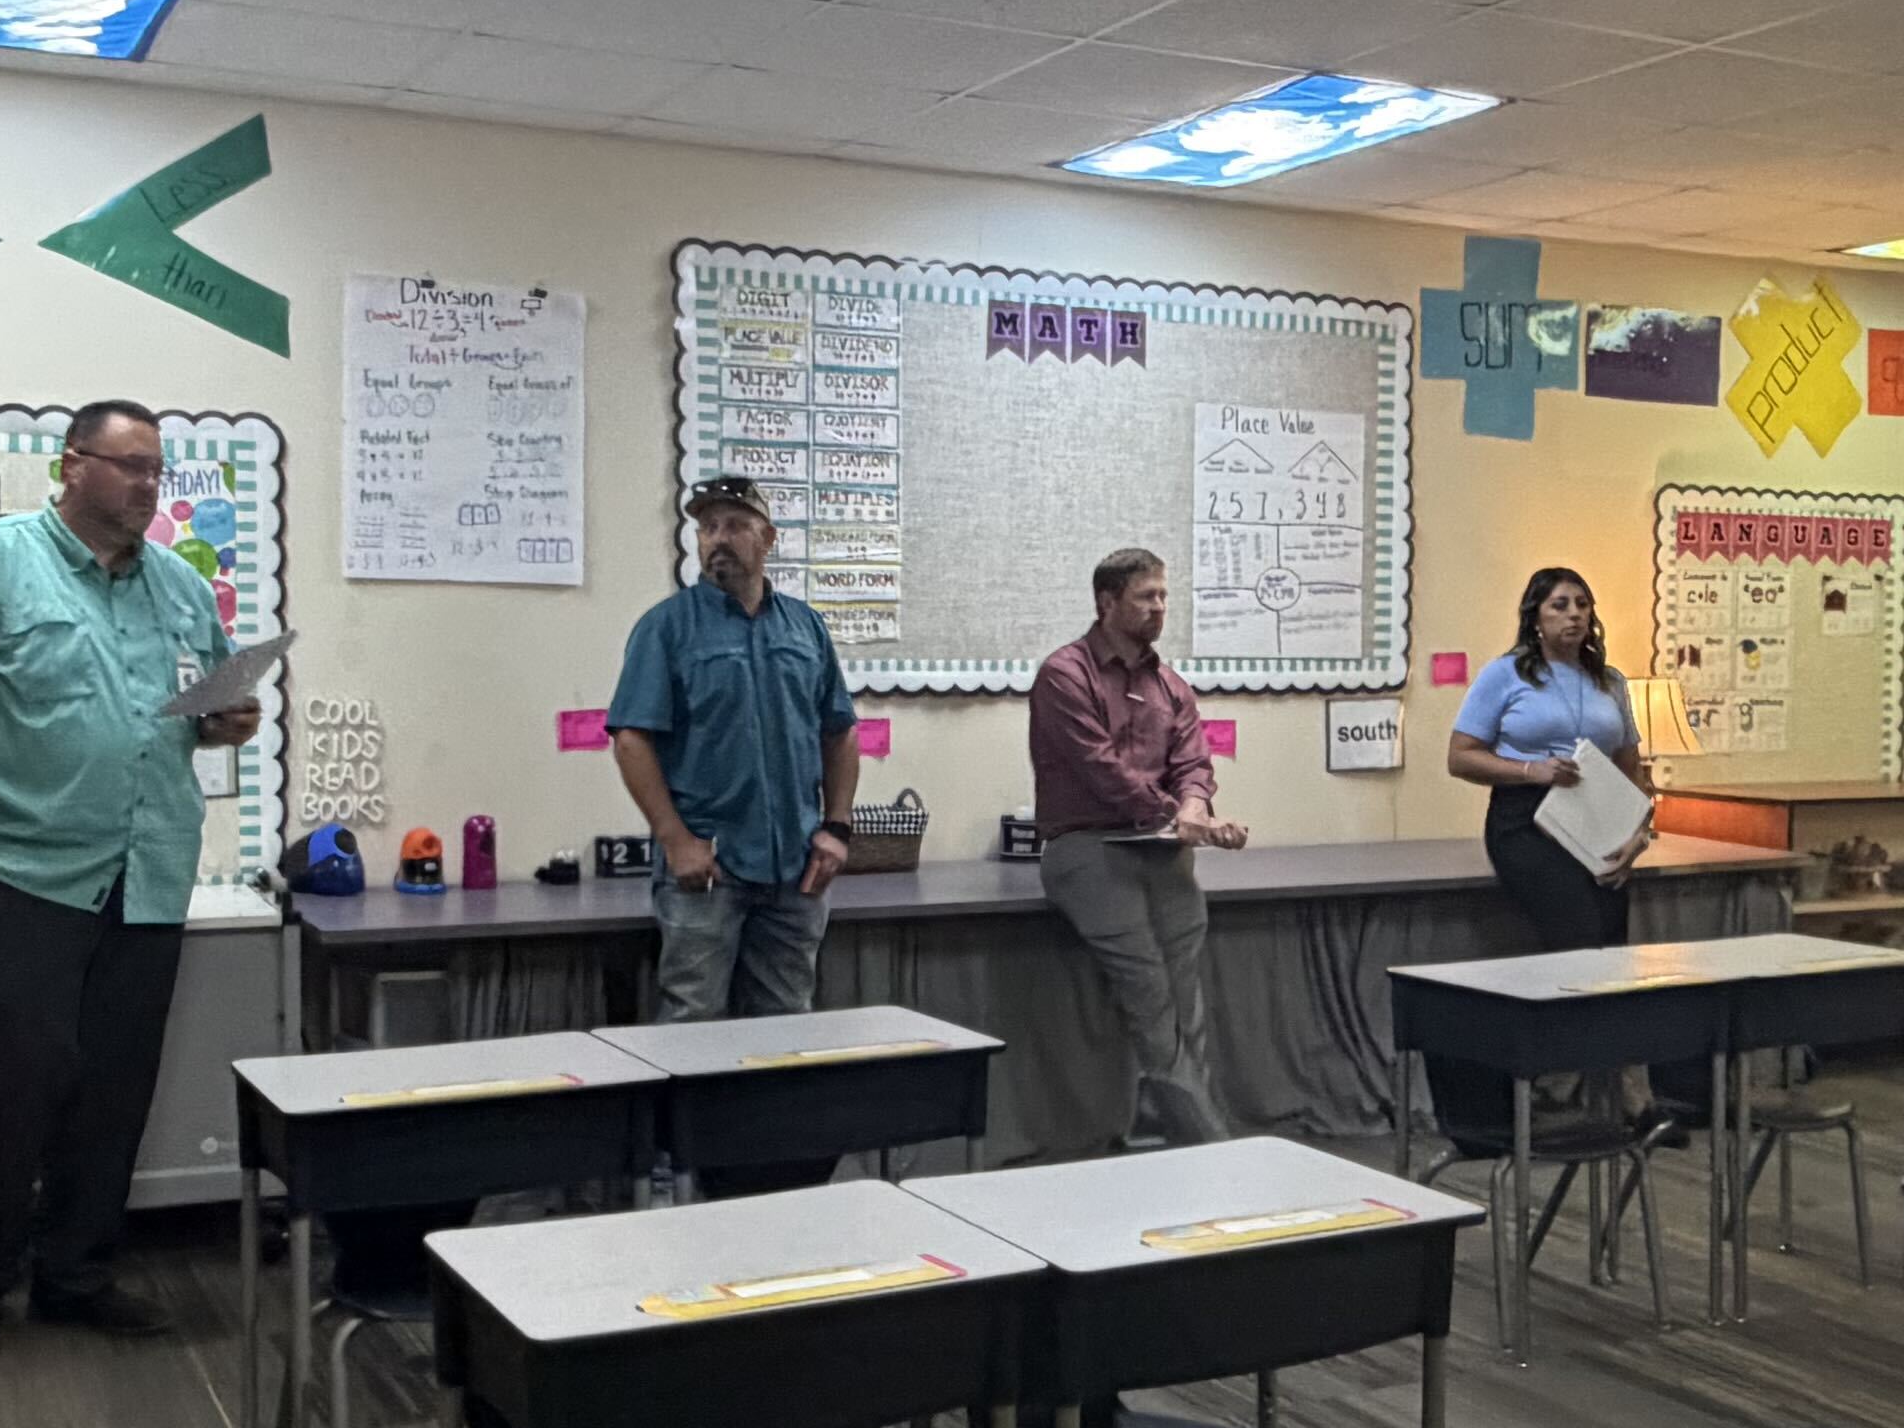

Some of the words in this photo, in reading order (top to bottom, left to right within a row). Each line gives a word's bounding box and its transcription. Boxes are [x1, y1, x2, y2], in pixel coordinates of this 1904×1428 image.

[163, 252, 228, 310] than
[401, 277, 494, 307] Division
[736, 290, 791, 307] DIGIT
[828, 295, 882, 313] DIVIDE
[995, 312, 1138, 345] MATH
[821, 335, 893, 353] DIVIDEND
[1747, 282, 1843, 444] product
[729, 368, 801, 388] MULTIPLY
[824, 374, 889, 391] DIVISOR
[736, 409, 793, 425] FACTOR
[1222, 406, 1270, 434] Place
[1279, 411, 1315, 434] Value
[732, 448, 796, 465] PRODUCT
[821, 453, 891, 469] EQUATION
[818, 490, 894, 506] MULTIPLES
[1682, 521, 1885, 548] LANGUAGE
[815, 573, 856, 588] WORD
[859, 573, 895, 588] FORM
[305, 699, 379, 726] COOL
[1337, 719, 1398, 742] south
[308, 730, 382, 760] KIDS
[305, 761, 381, 791] READ
[302, 792, 385, 822] BOOKS
